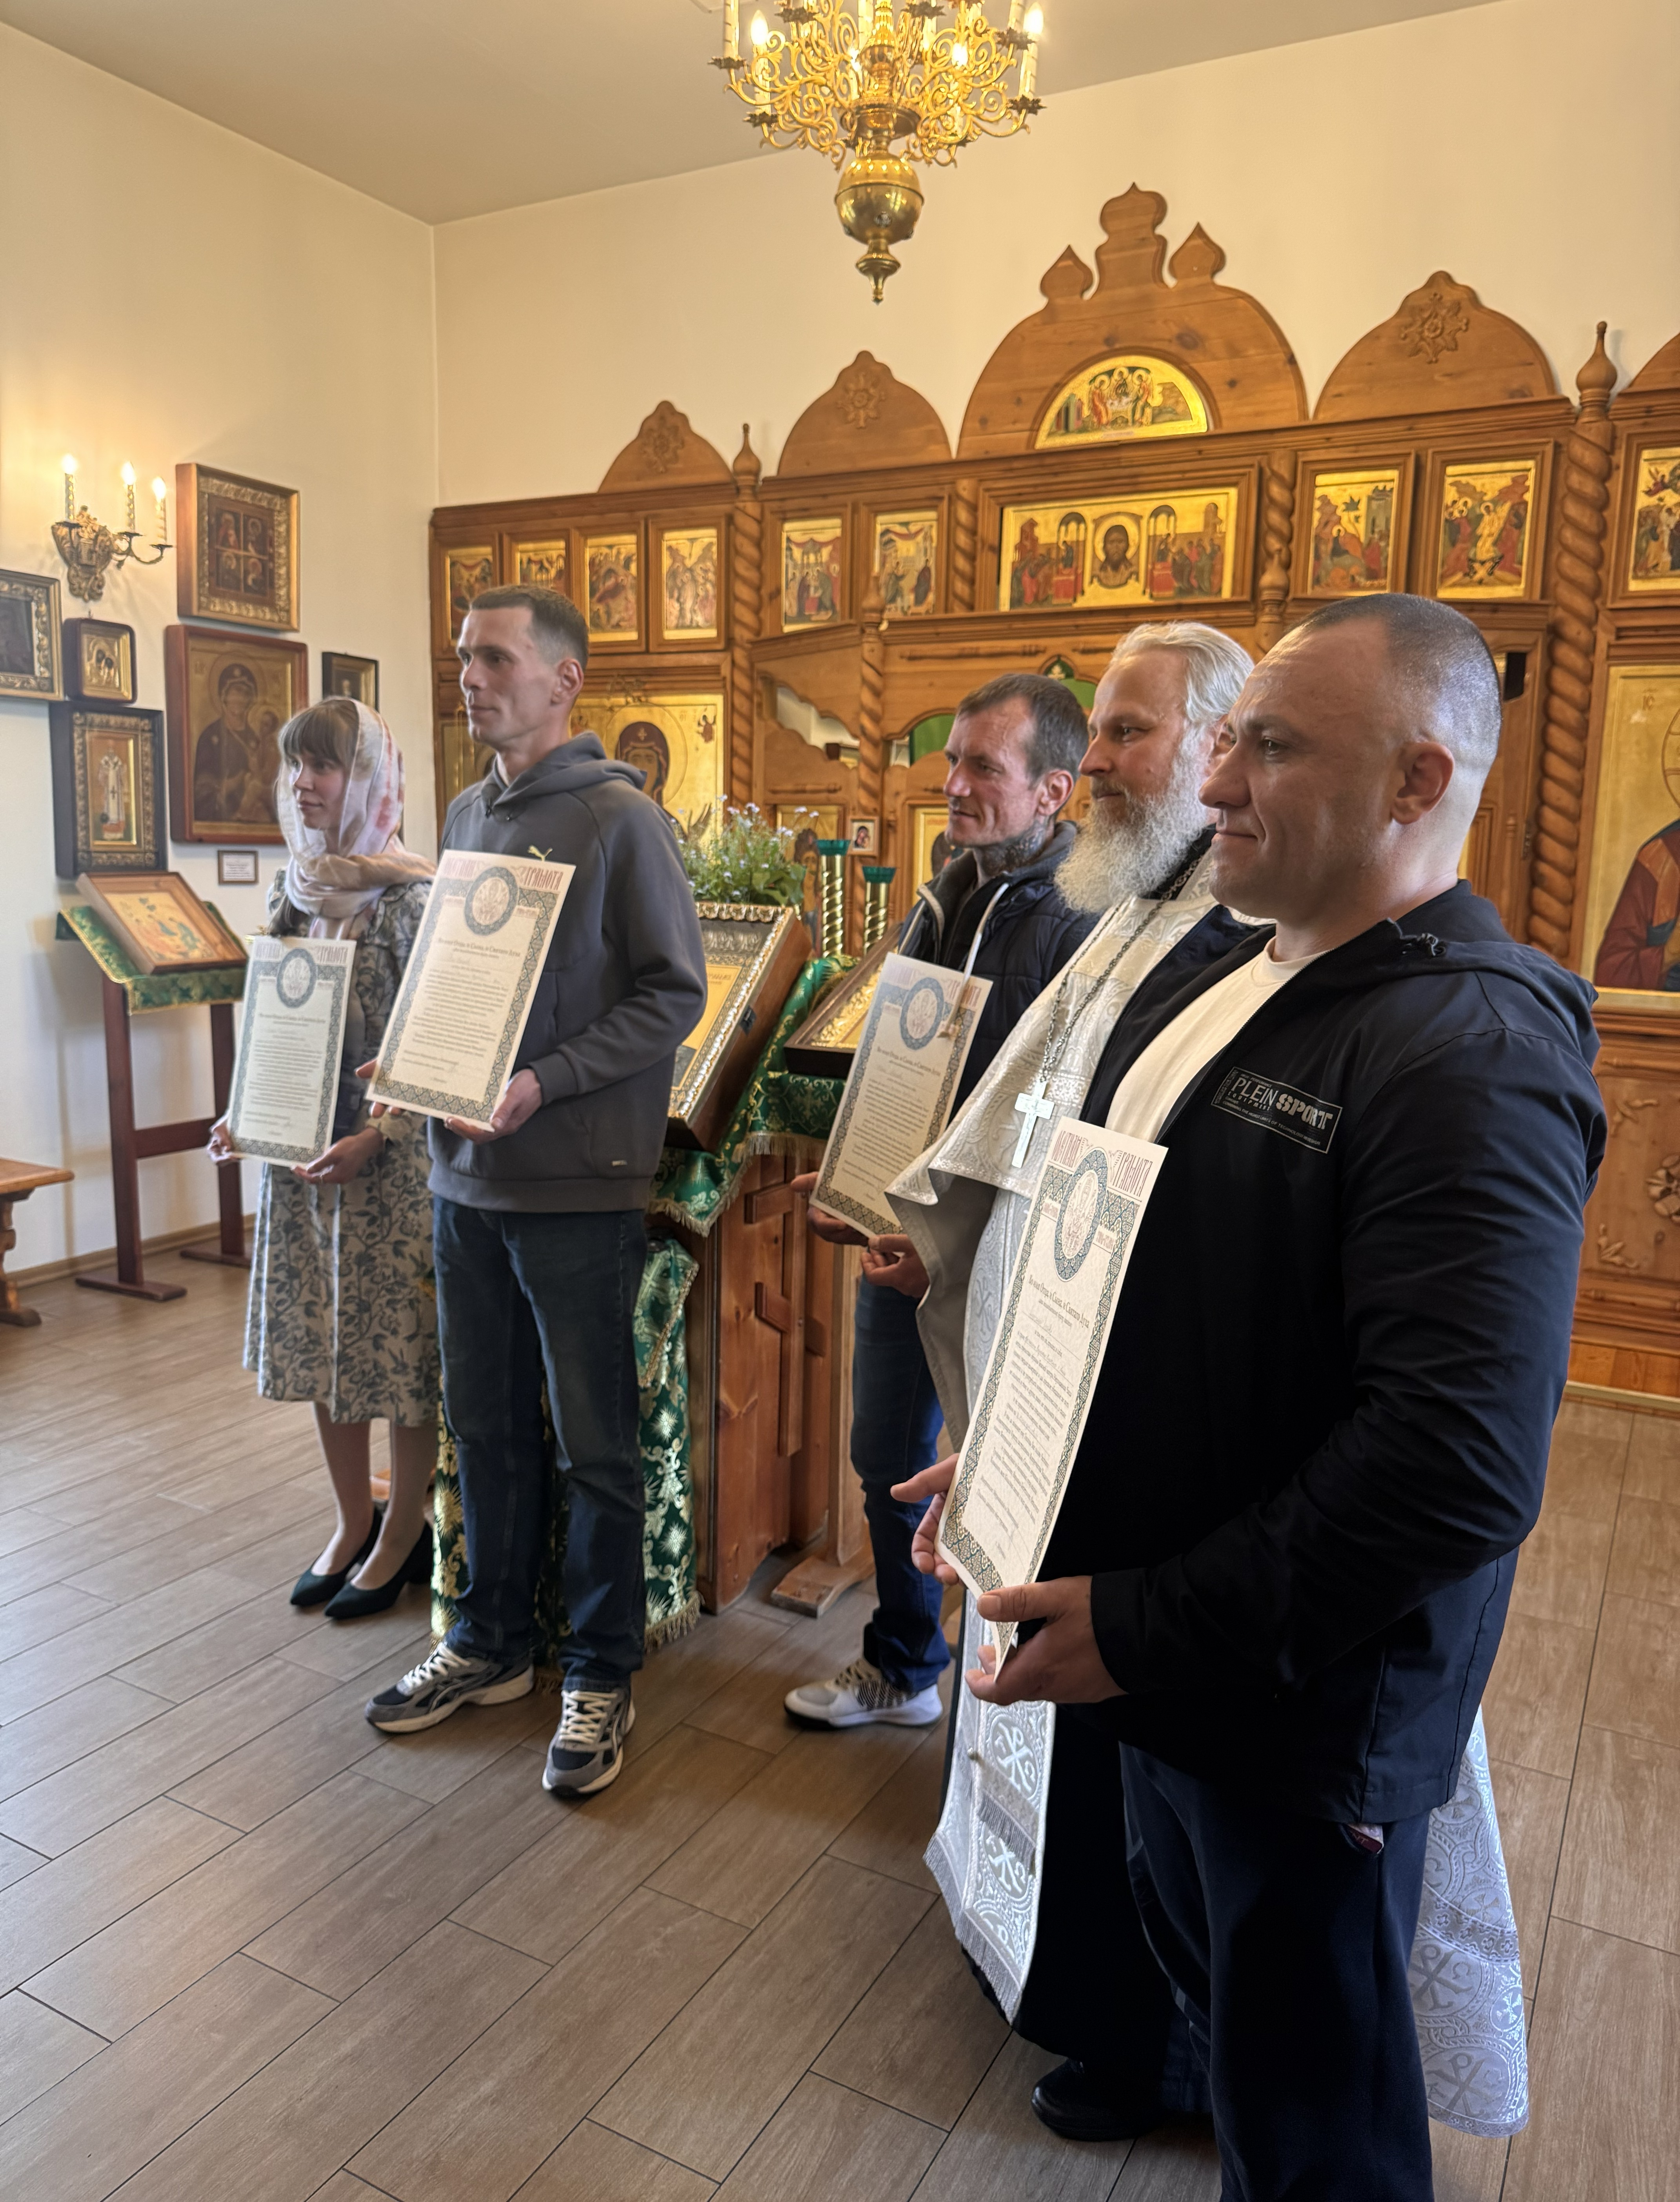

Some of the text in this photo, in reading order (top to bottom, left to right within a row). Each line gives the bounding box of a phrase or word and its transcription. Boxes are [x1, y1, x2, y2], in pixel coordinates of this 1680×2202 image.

[1231, 1077, 1279, 1106] PLEIN
[1276, 1094, 1333, 1130] SPORT
[1112, 1152, 1153, 1197] ГРАМОТА
[1065, 1301, 1080, 1321] Святаго
[1079, 1312, 1089, 1329] Духа
